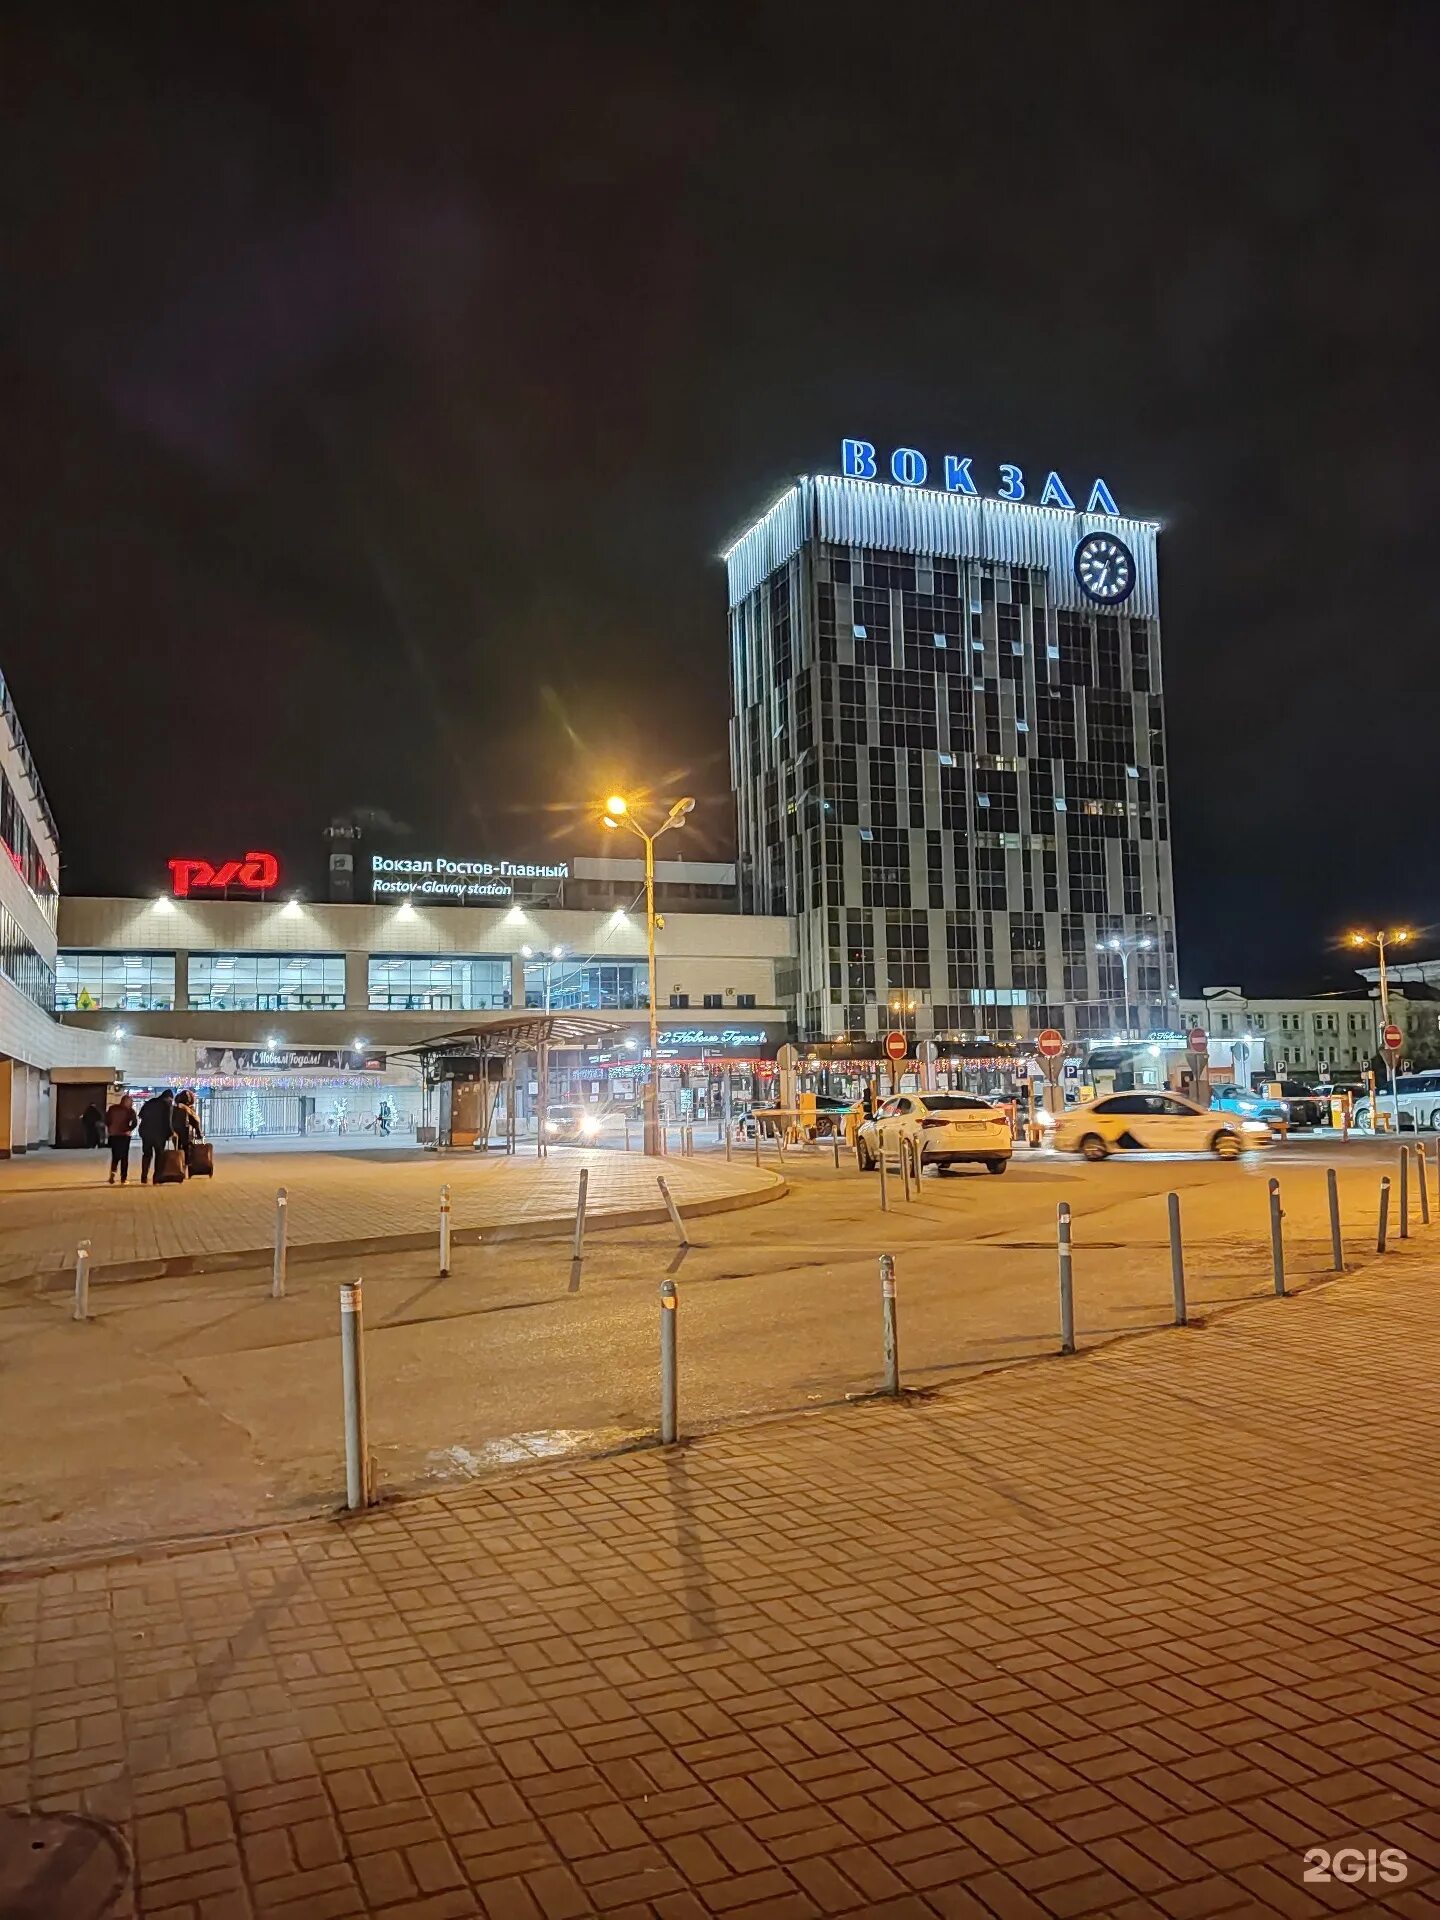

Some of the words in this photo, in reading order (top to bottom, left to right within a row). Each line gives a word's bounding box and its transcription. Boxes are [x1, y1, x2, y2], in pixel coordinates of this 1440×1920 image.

[842, 438, 1120, 516] ВОКЗАЛ
[372, 855, 432, 873] Вокзал
[436, 858, 569, 878] Ростов-Главный
[372, 879, 466, 897] Rostov-Glavny
[467, 881, 512, 895] station
